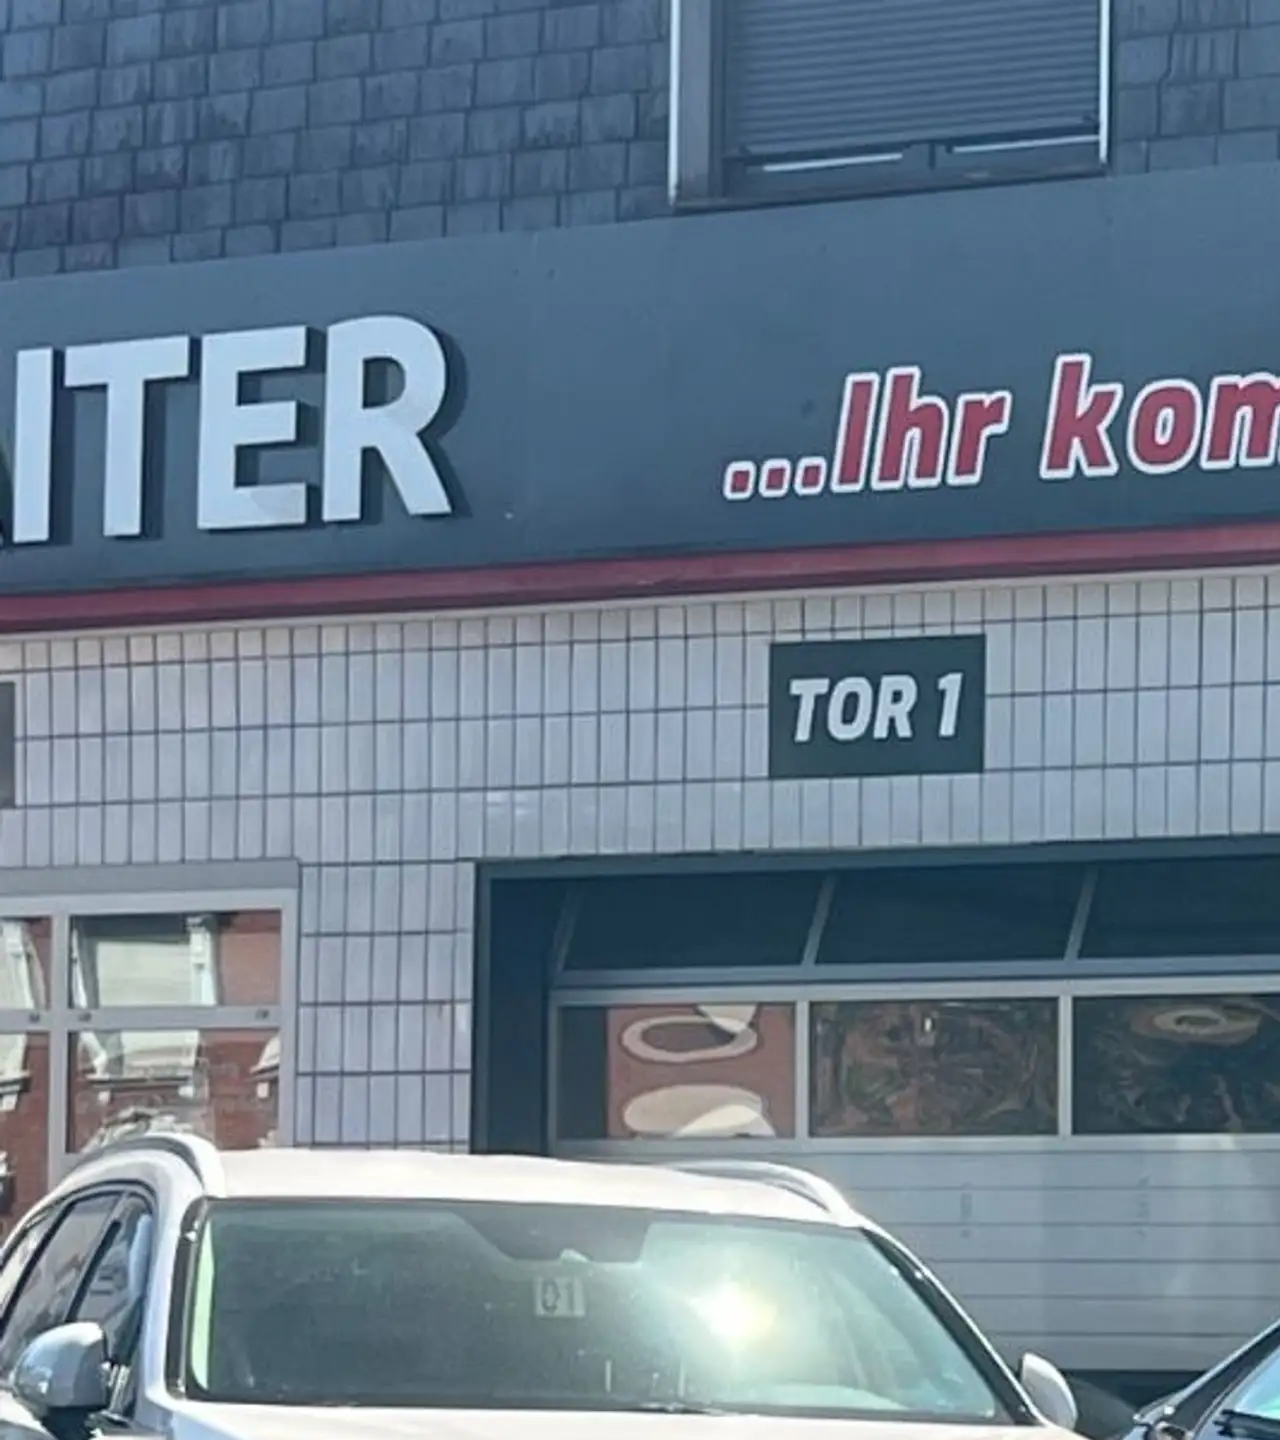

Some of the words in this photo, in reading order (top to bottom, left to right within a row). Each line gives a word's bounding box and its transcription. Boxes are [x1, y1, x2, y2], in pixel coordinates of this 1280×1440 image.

[0, 315, 452, 544] ITER
[722, 365, 1012, 502] ...Ihr
[789, 674, 918, 743] TOR
[937, 671, 964, 737] 1
